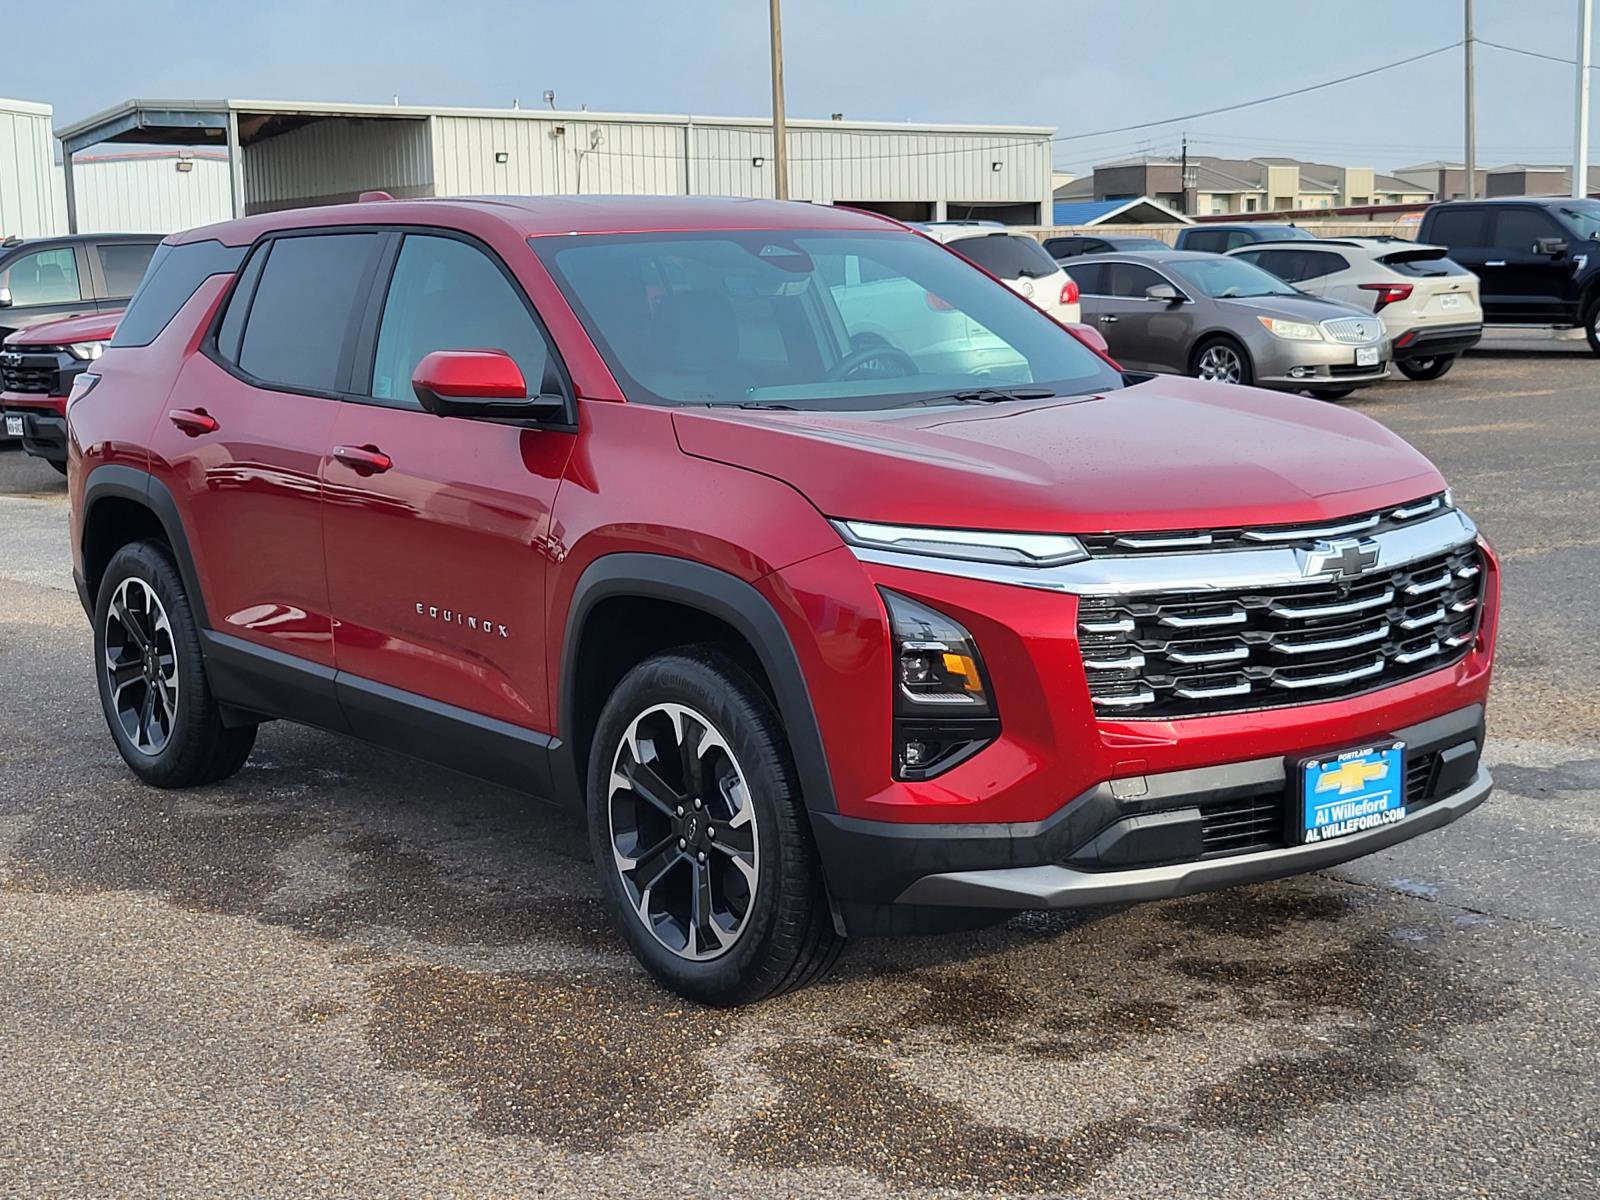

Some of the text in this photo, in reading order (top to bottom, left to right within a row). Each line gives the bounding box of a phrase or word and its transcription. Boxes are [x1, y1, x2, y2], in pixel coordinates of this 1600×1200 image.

[416, 603, 507, 638] EQUINOX
[1337, 748, 1374, 761] PORTLAND
[1305, 807, 1406, 843] AL WILLEFORD.COM
[1316, 795, 1388, 826] Al Willeford
